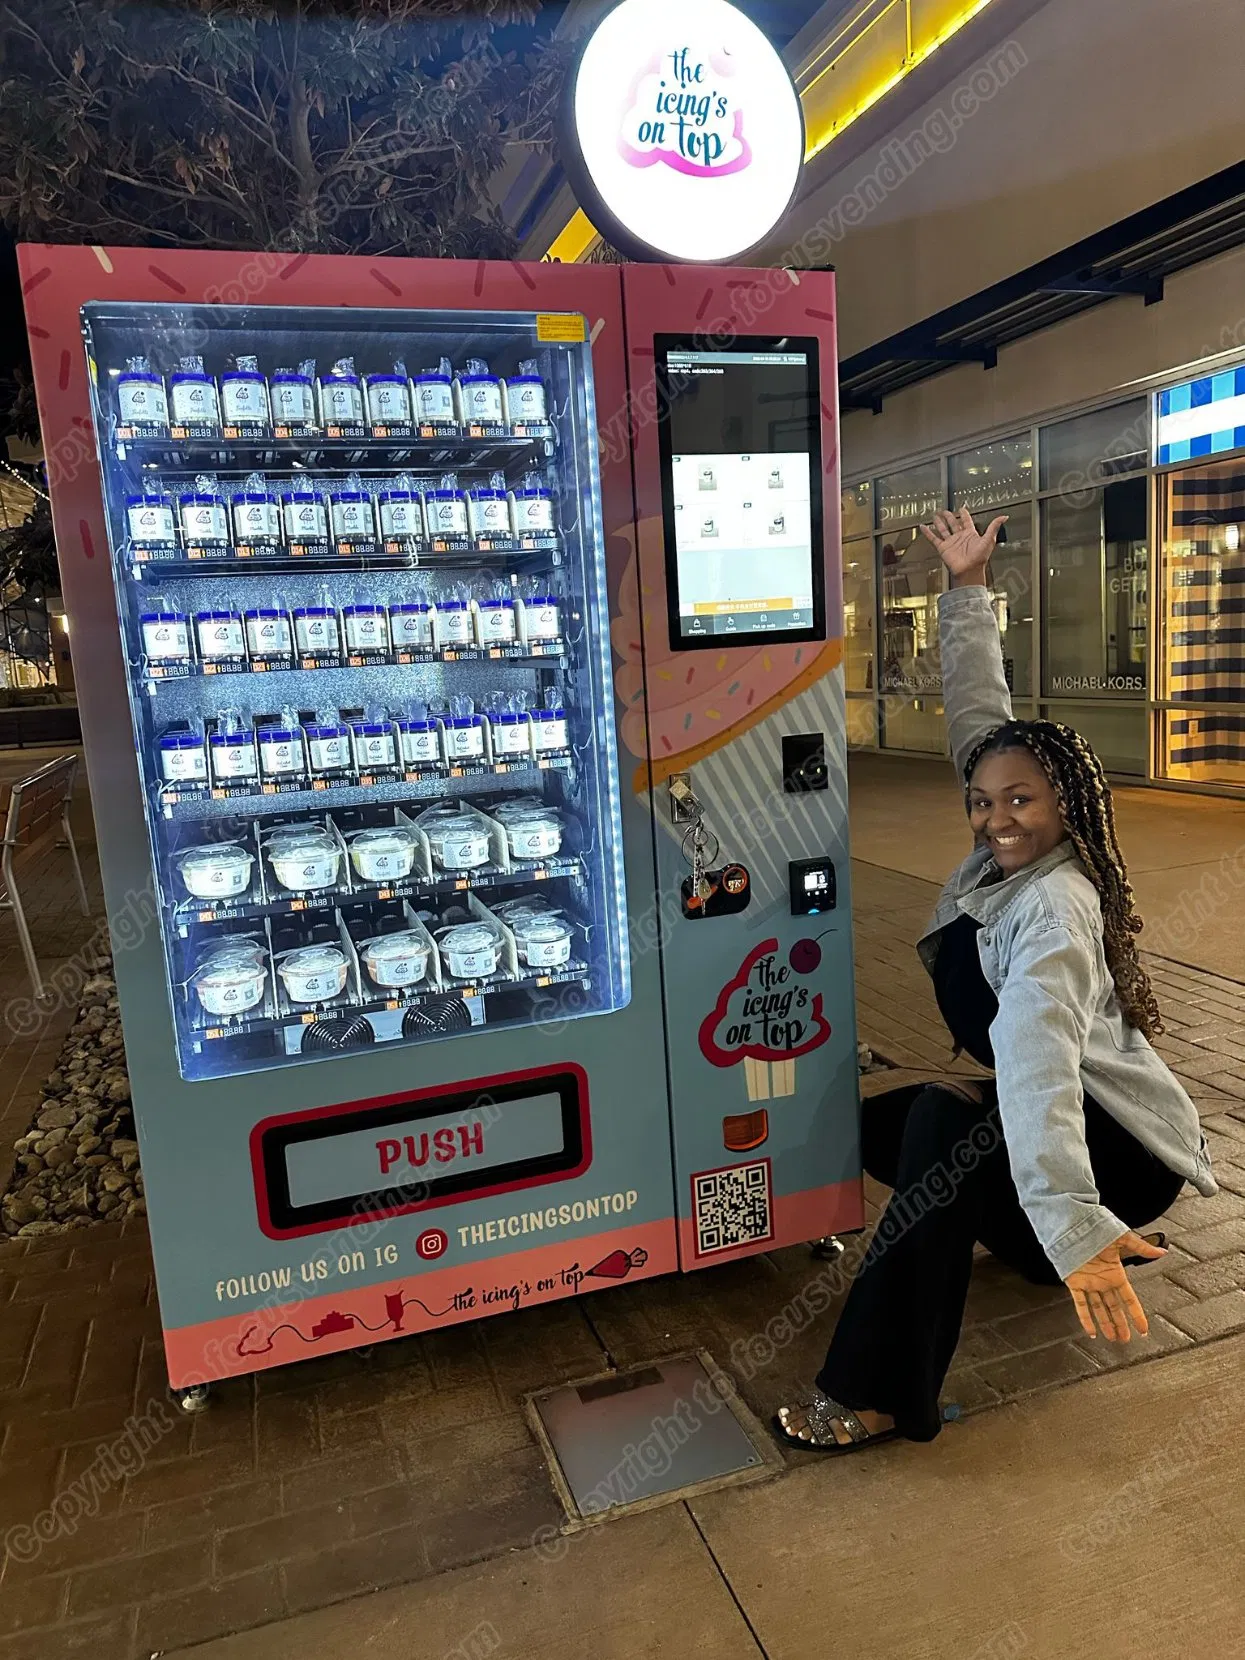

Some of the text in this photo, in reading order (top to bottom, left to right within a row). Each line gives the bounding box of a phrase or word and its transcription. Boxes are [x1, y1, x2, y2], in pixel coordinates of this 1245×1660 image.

[668, 47, 705, 82] the
[656, 81, 727, 126] icing's
[638, 115, 727, 166] on top
[1052, 676, 1142, 690] MICHAEL KORS
[753, 956, 790, 988] the
[742, 985, 808, 1018] icing's
[726, 1012, 808, 1050] on top
[375, 1122, 484, 1174] PUSH
[374, 1244, 399, 1267] IG
[457, 1189, 638, 1247] THEICINGSONTOP
[449, 1262, 585, 1311] the icing's on top
